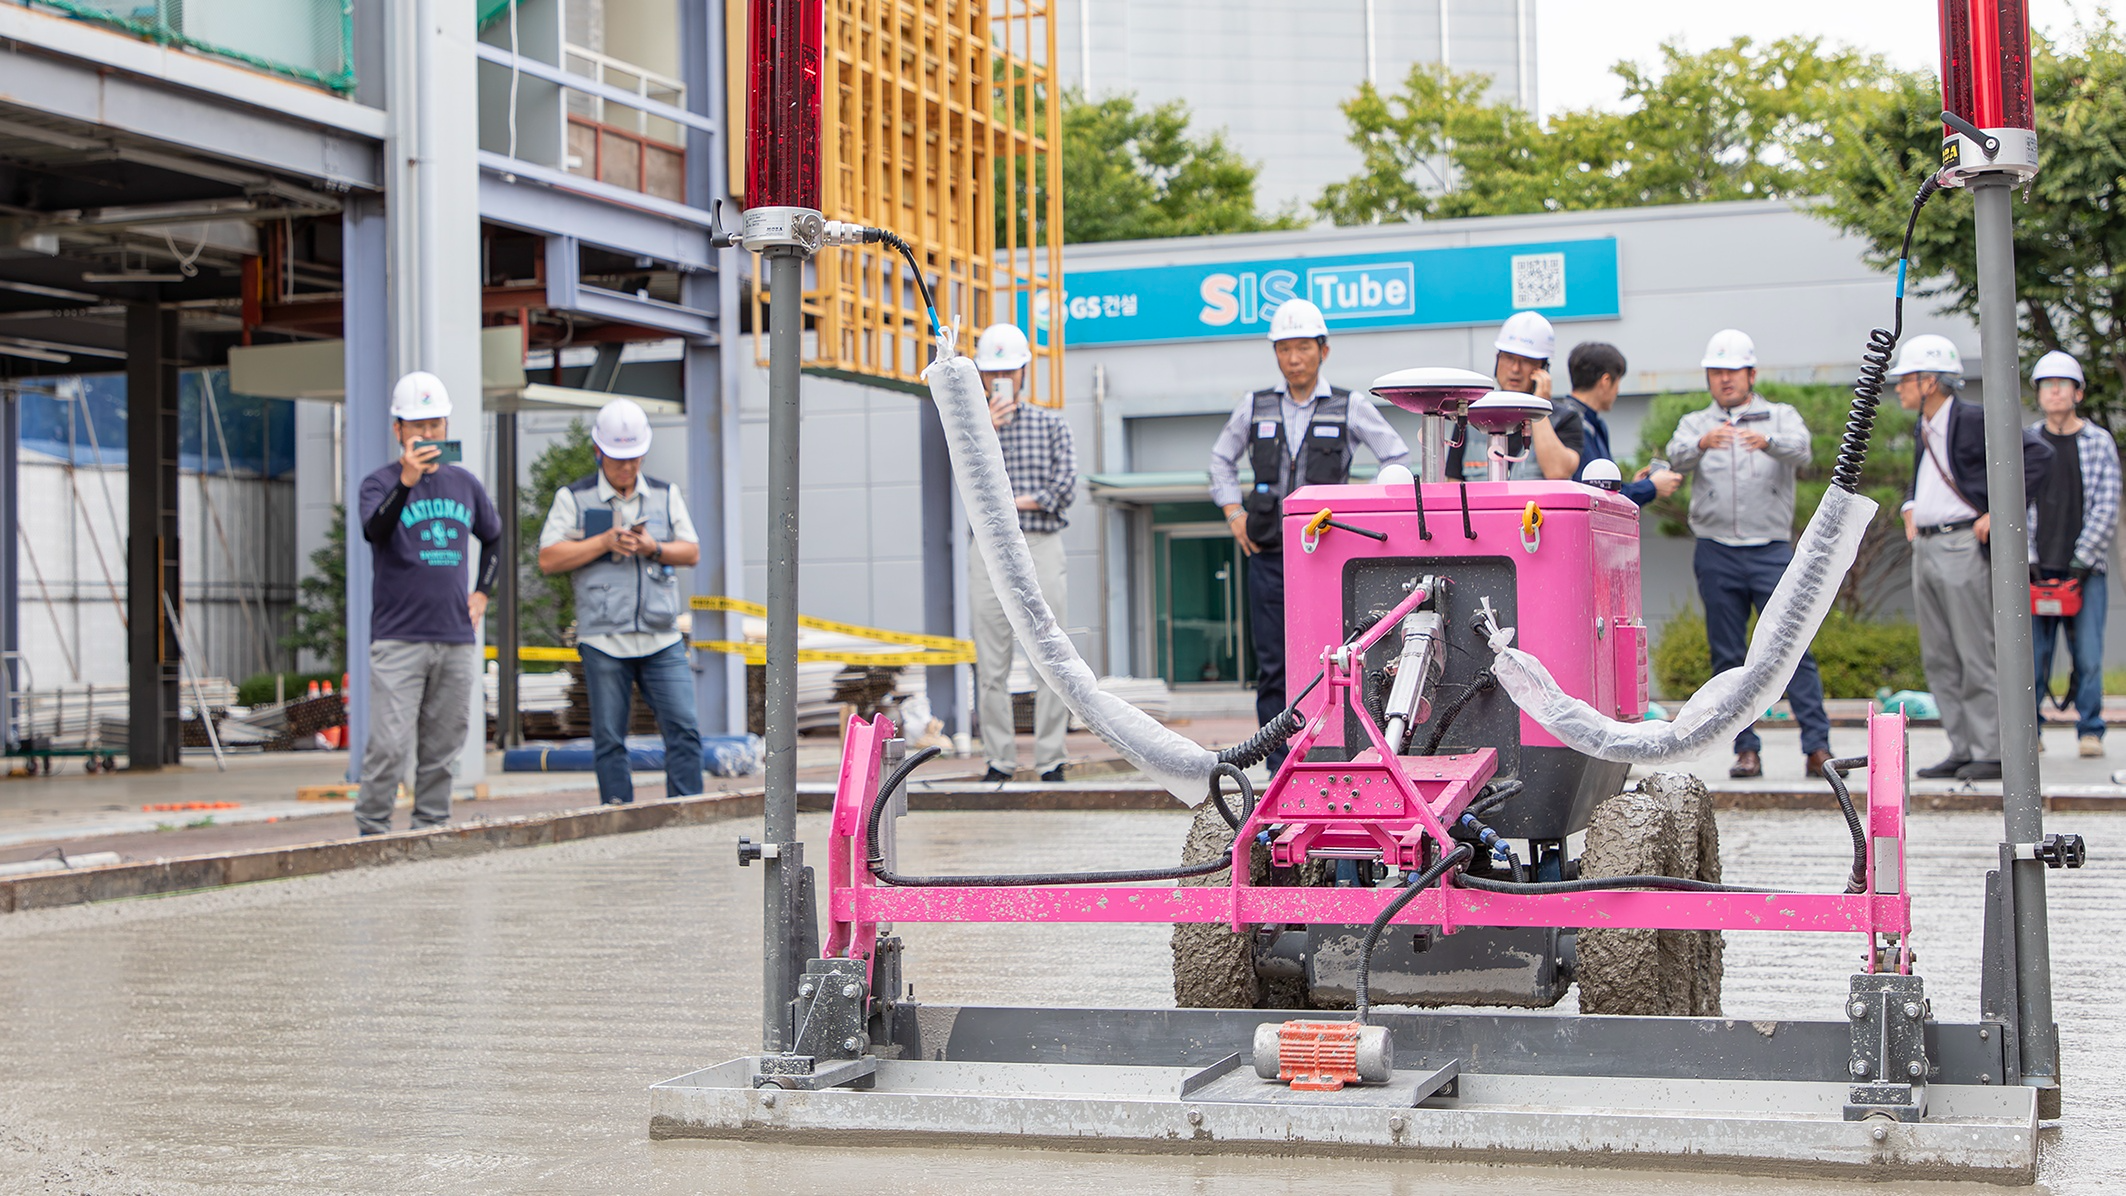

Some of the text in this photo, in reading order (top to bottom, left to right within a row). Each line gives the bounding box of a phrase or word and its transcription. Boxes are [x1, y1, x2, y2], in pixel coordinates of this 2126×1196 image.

[1199, 270, 1407, 326] SIS Tube
[401, 498, 471, 528] NATIONAL
